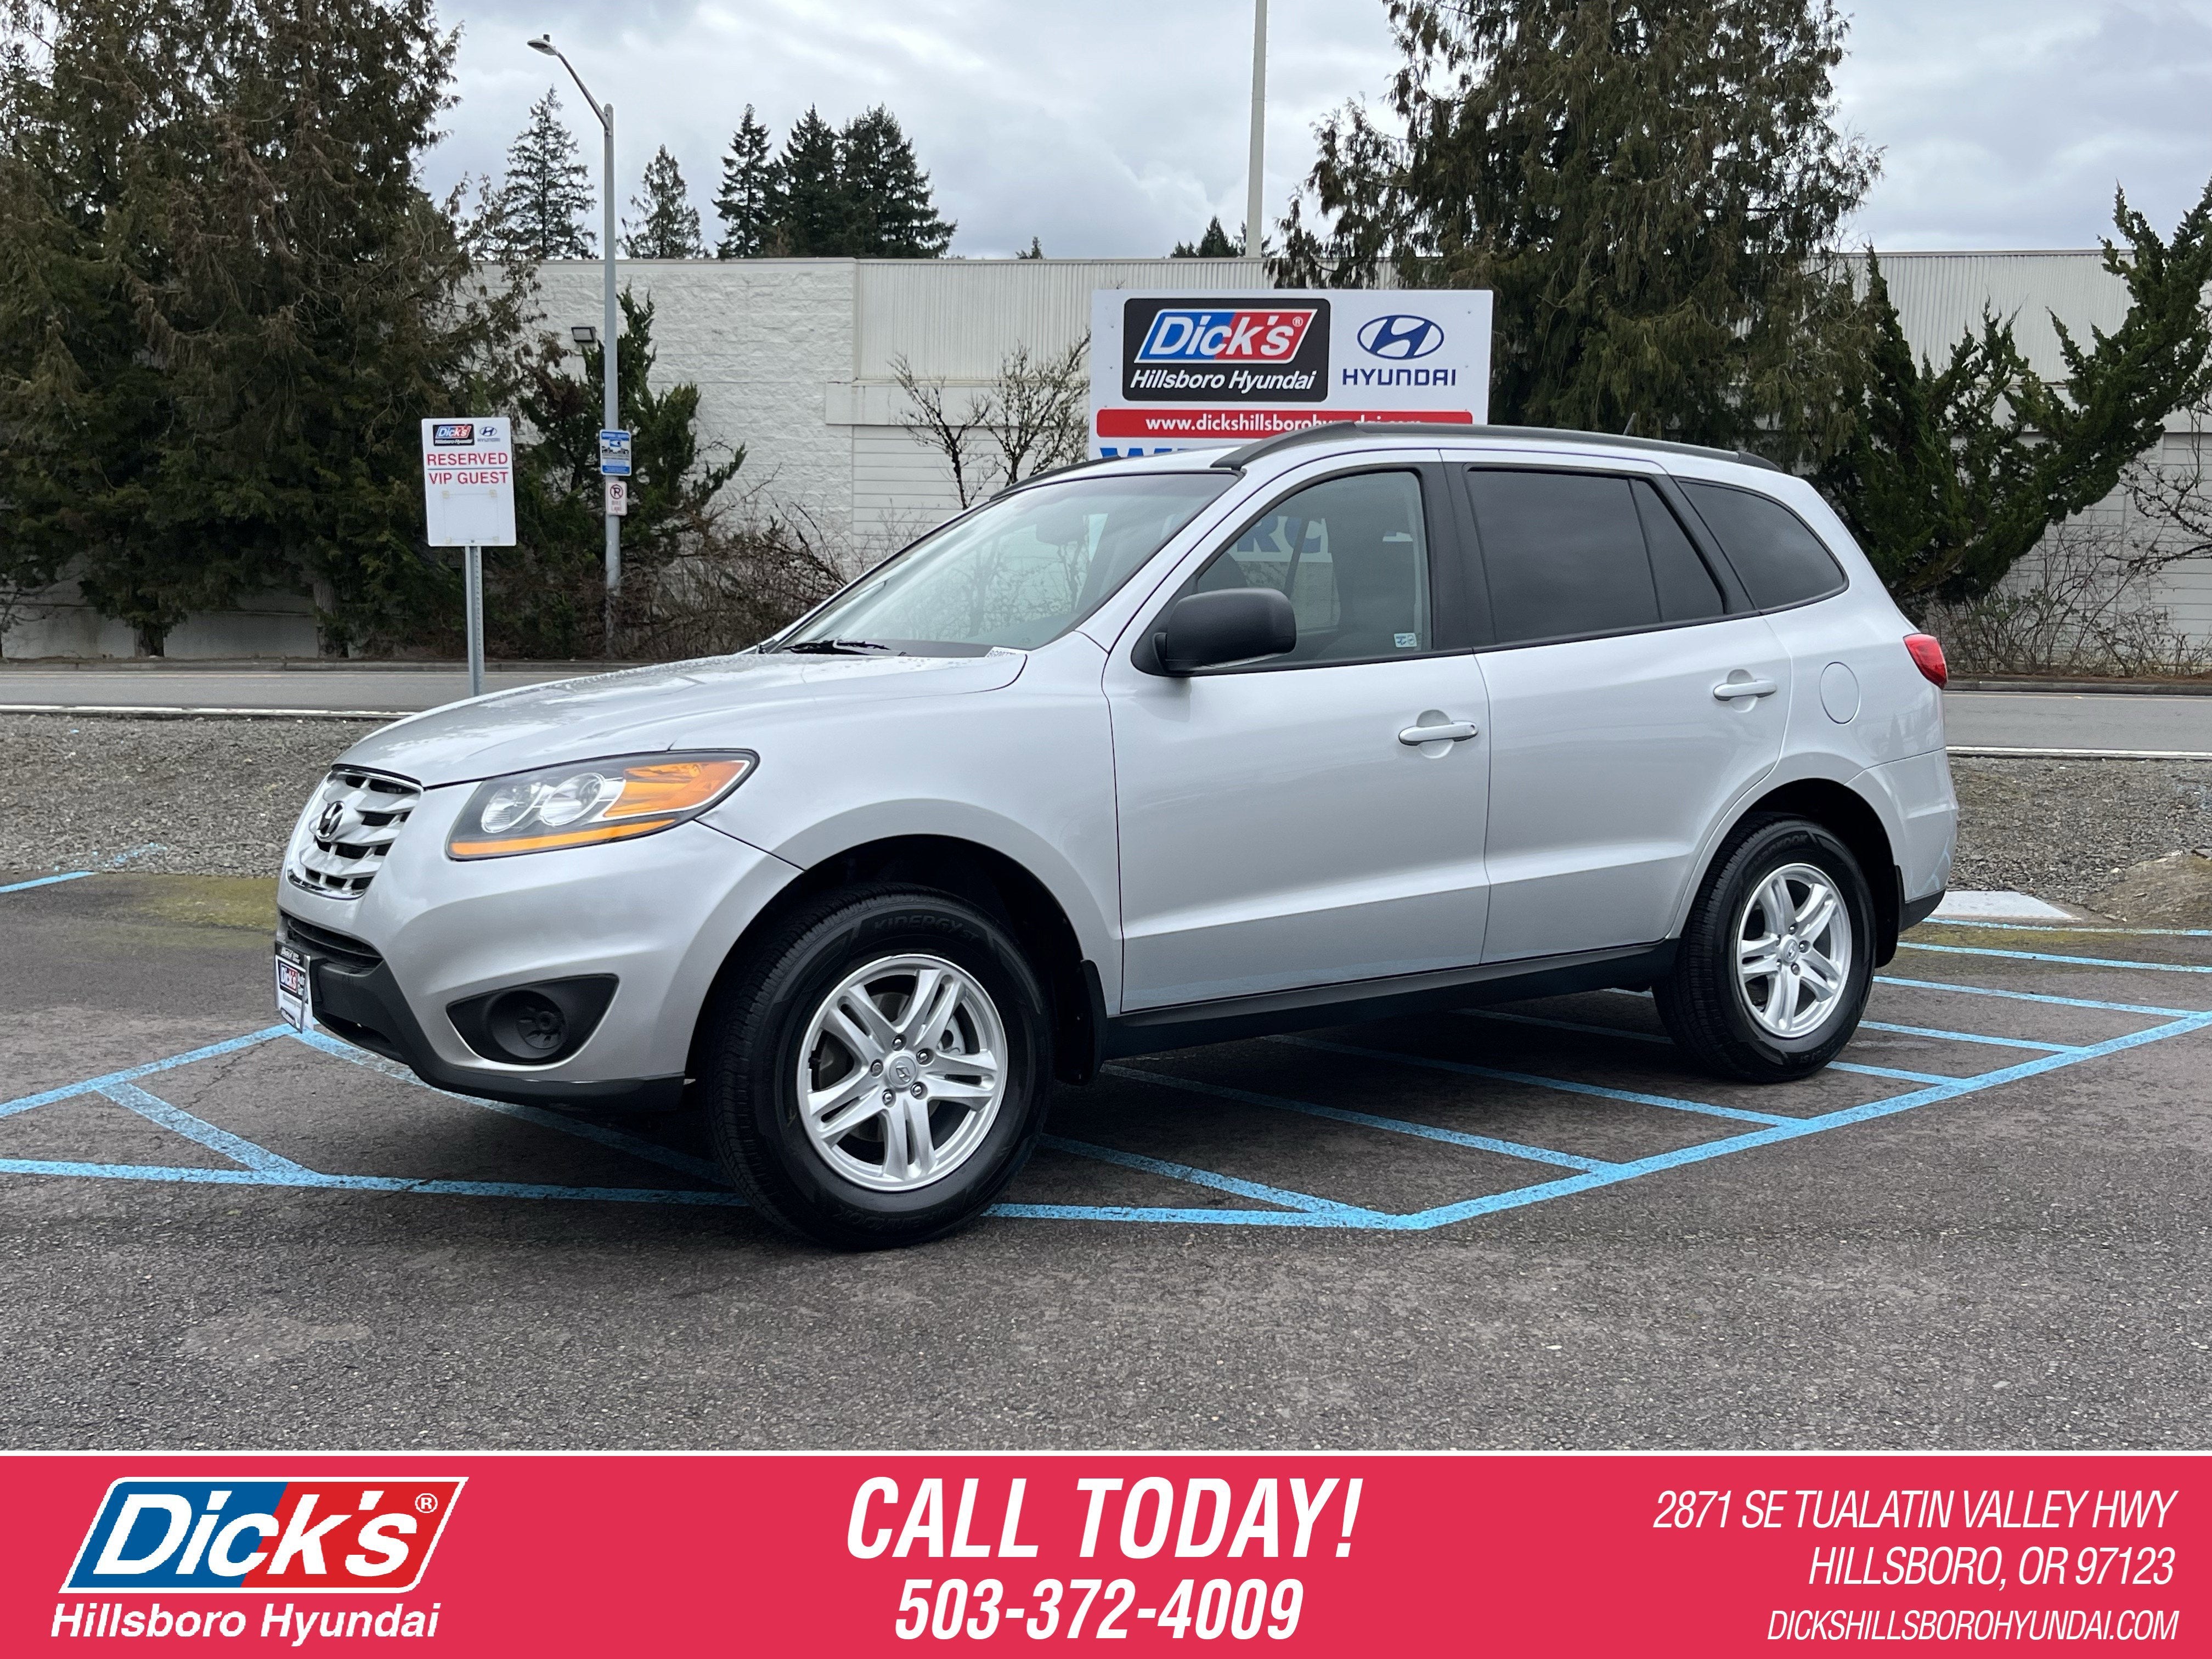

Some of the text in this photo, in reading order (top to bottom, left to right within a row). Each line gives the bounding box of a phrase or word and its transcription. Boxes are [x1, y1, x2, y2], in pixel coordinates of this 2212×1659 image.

[1130, 369, 1317, 394] Hillsboro Hyundai
[1343, 369, 1455, 386] HYUNDAI
[1146, 413, 1421, 432] www.dickshillsboroh
[427, 453, 508, 466] RESERVED
[429, 472, 509, 484] VIP GUEST
